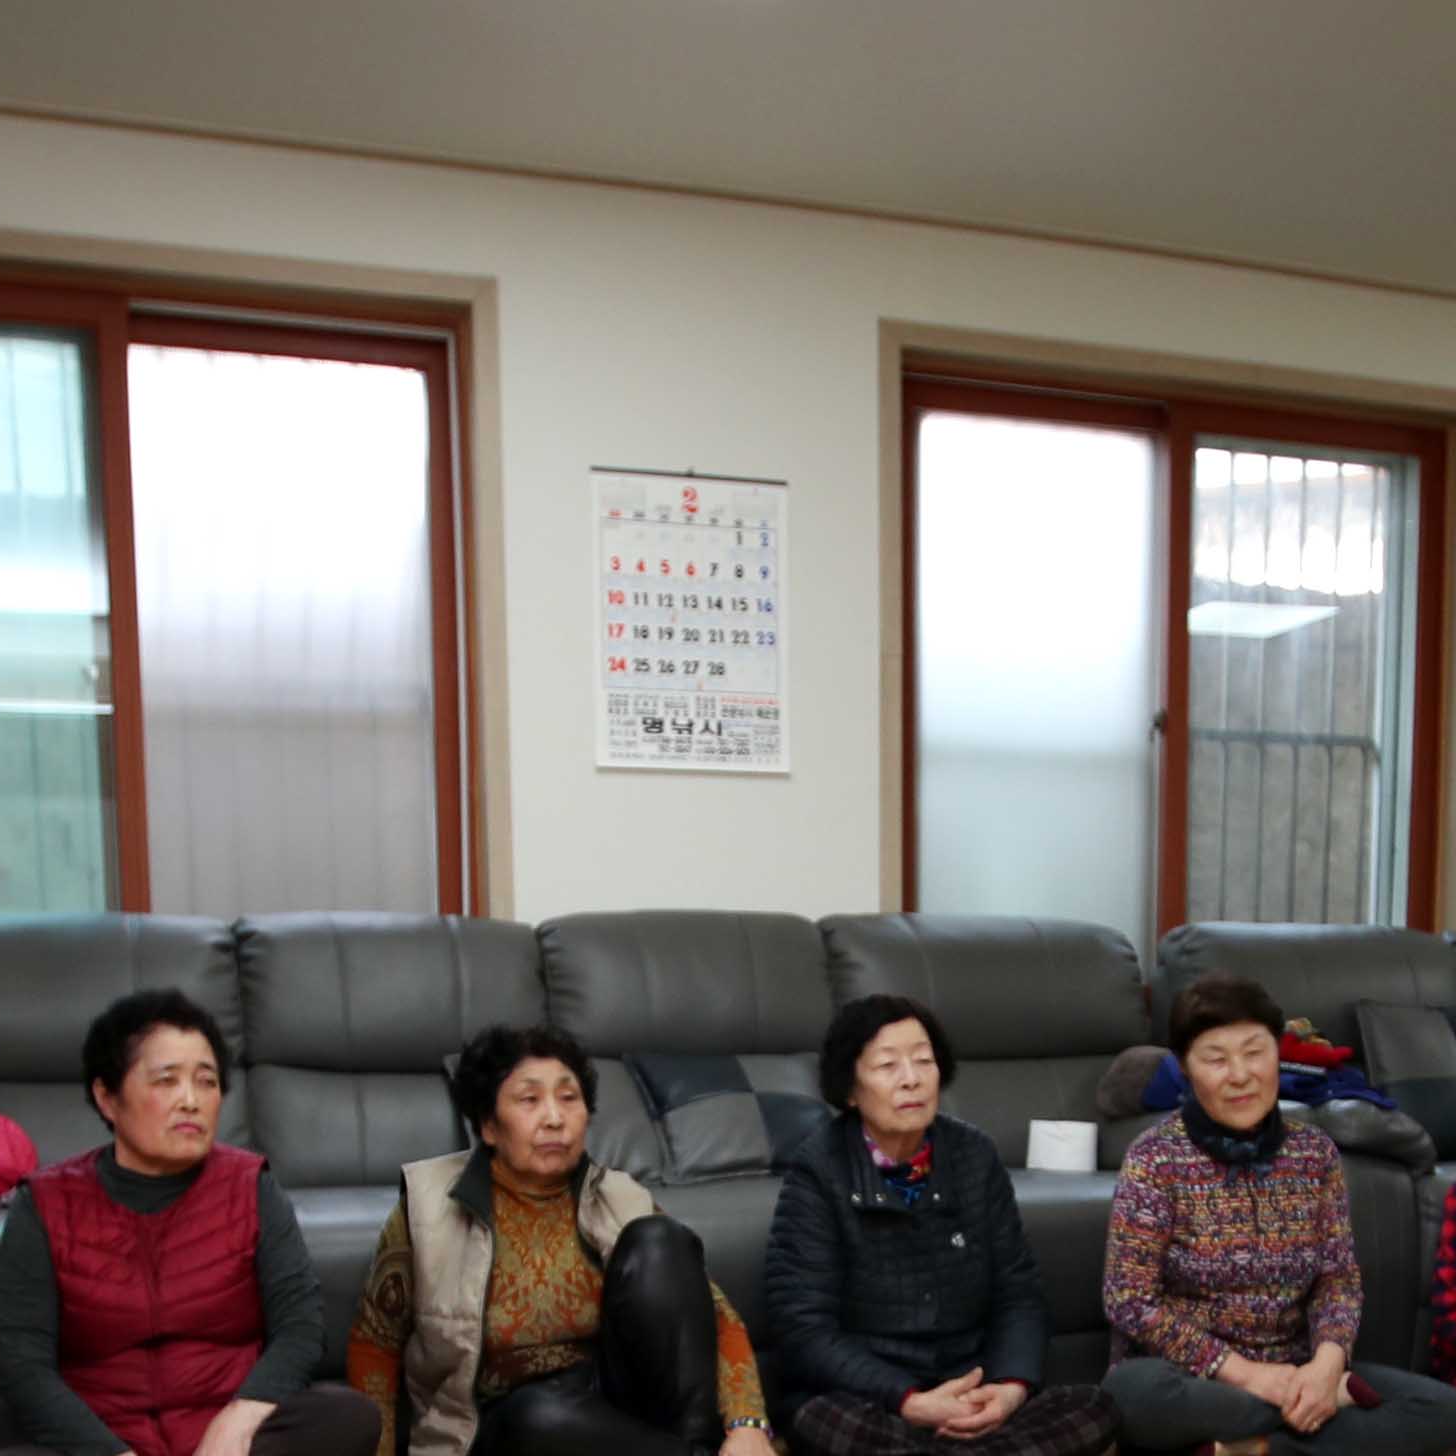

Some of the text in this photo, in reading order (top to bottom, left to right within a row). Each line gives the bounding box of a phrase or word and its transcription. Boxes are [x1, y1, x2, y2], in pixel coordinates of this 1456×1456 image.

[681, 486, 699, 514] 2
[735, 531, 769, 547] 1 2
[610, 555, 769, 580] 3 4 5 6 7 8 9
[608, 590, 774, 614] 10 11 12 13 14 15 16
[608, 623, 776, 646] 17 18 19 20 21 22 23
[608, 656, 726, 677] 24 25 26 27 28
